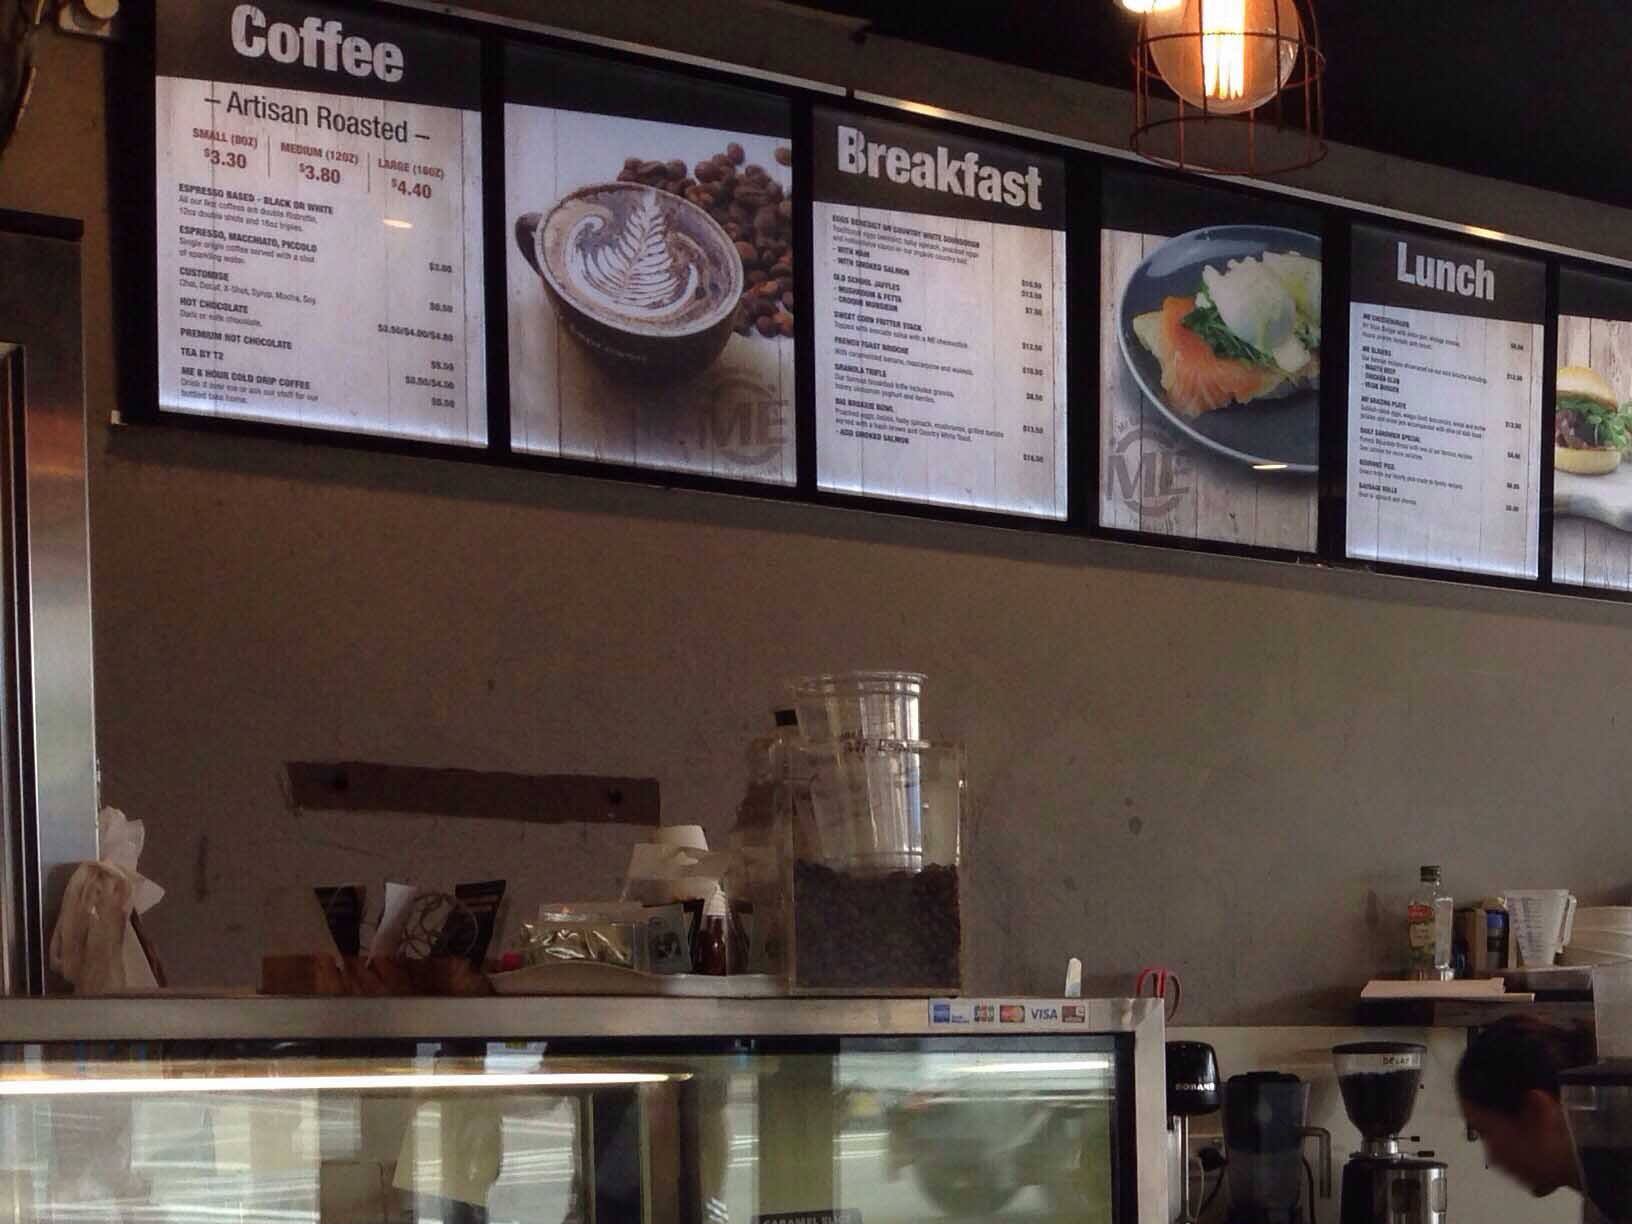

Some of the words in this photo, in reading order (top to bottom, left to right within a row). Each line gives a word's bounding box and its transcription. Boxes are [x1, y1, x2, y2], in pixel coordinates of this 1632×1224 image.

[230, 4, 404, 83] Coffee
[227, 91, 308, 125] Artisan
[317, 106, 408, 143] Roasted
[192, 128, 227, 144] SMALL
[204, 148, 247, 169] $3.30
[280, 142, 322, 158] MEDIUM
[299, 163, 340, 184] $3.80
[378, 159, 409, 173] LARGE
[837, 125, 1043, 211] Breakfast
[179, 183, 224, 198] ESPRESSO
[391, 178, 432, 199] $4.40
[1397, 241, 1495, 301] Lunch
[1031, 1008, 1057, 1019] VISA
